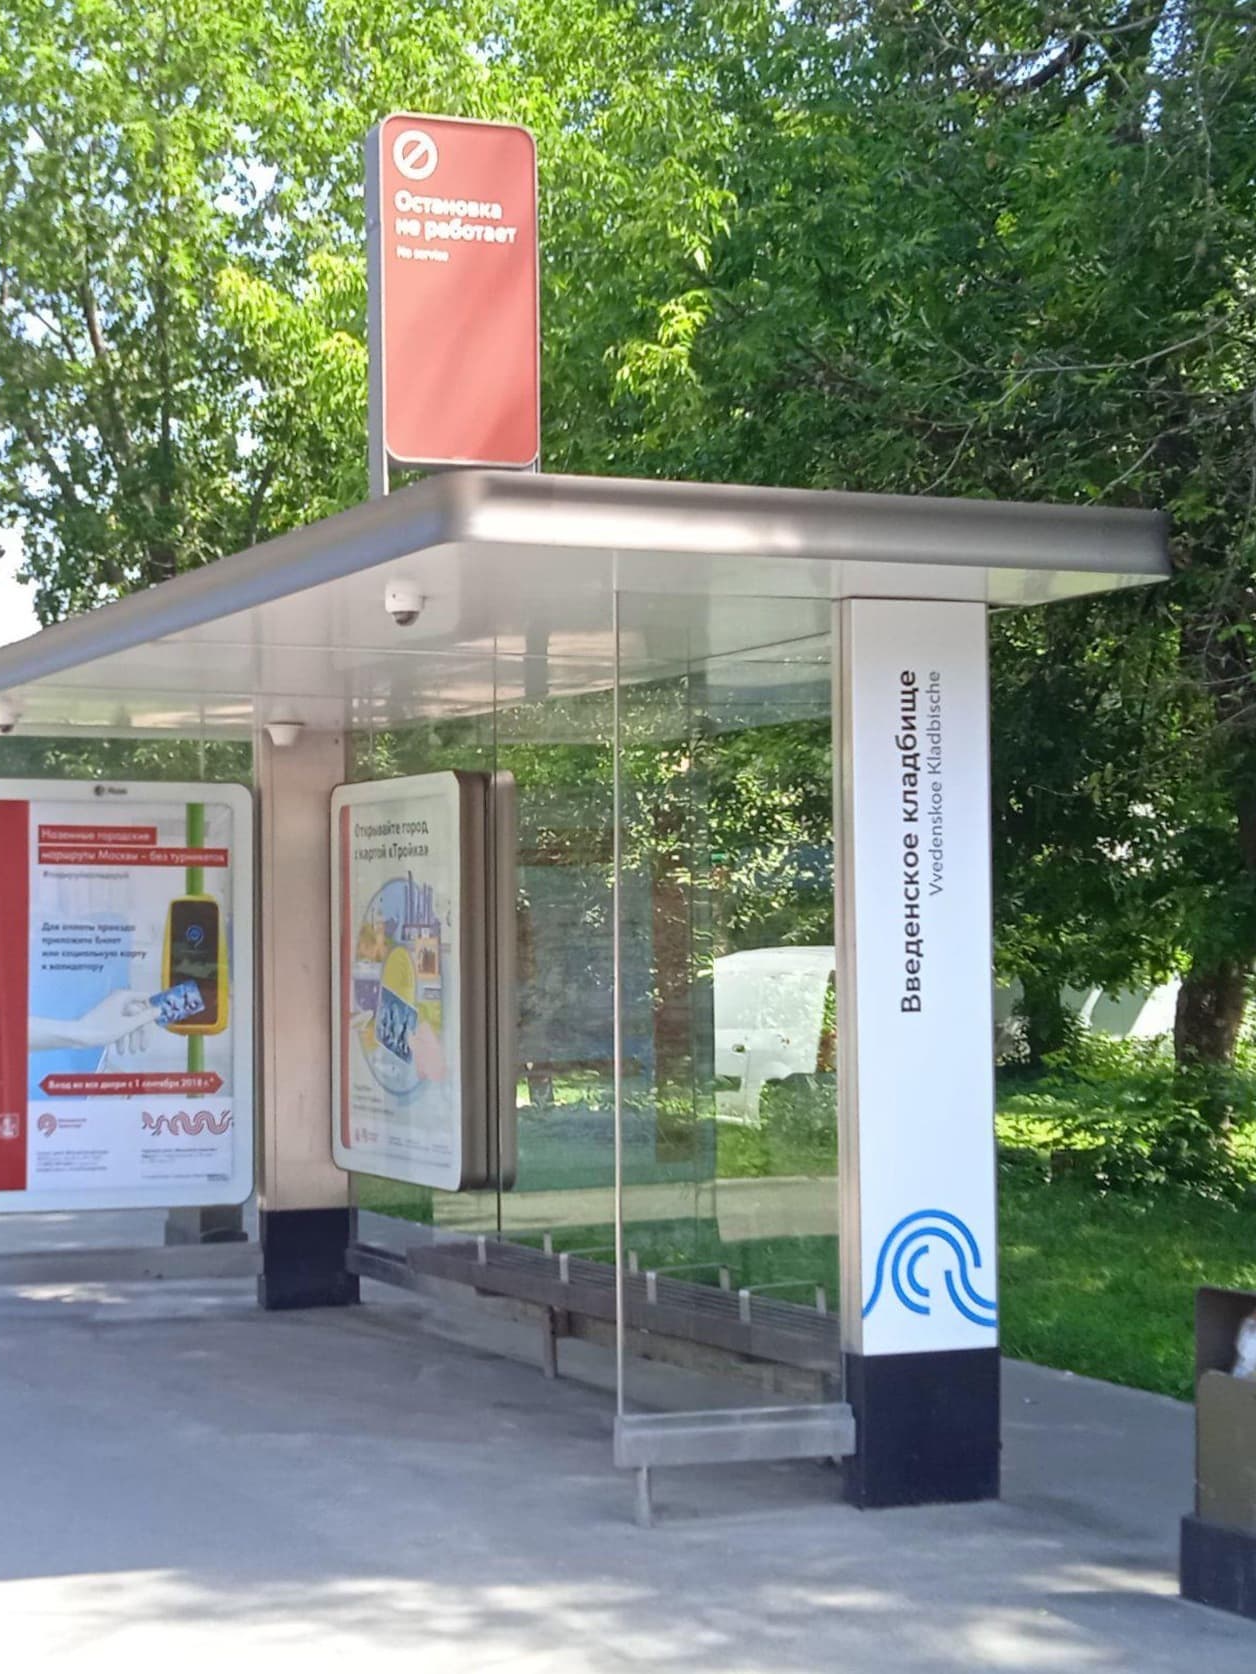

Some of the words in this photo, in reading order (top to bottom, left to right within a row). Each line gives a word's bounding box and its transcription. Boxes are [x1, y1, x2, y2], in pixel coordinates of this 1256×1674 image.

[394, 189, 503, 220] Остановка
[395, 217, 421, 237] не
[424, 217, 517, 244] работает
[894, 670, 920, 823] кладбище
[925, 671, 942, 775] Kladbische
[402, 820, 429, 837] город
[927, 781, 944, 897] Vvedenskoe
[900, 833, 924, 1013] Введенское
